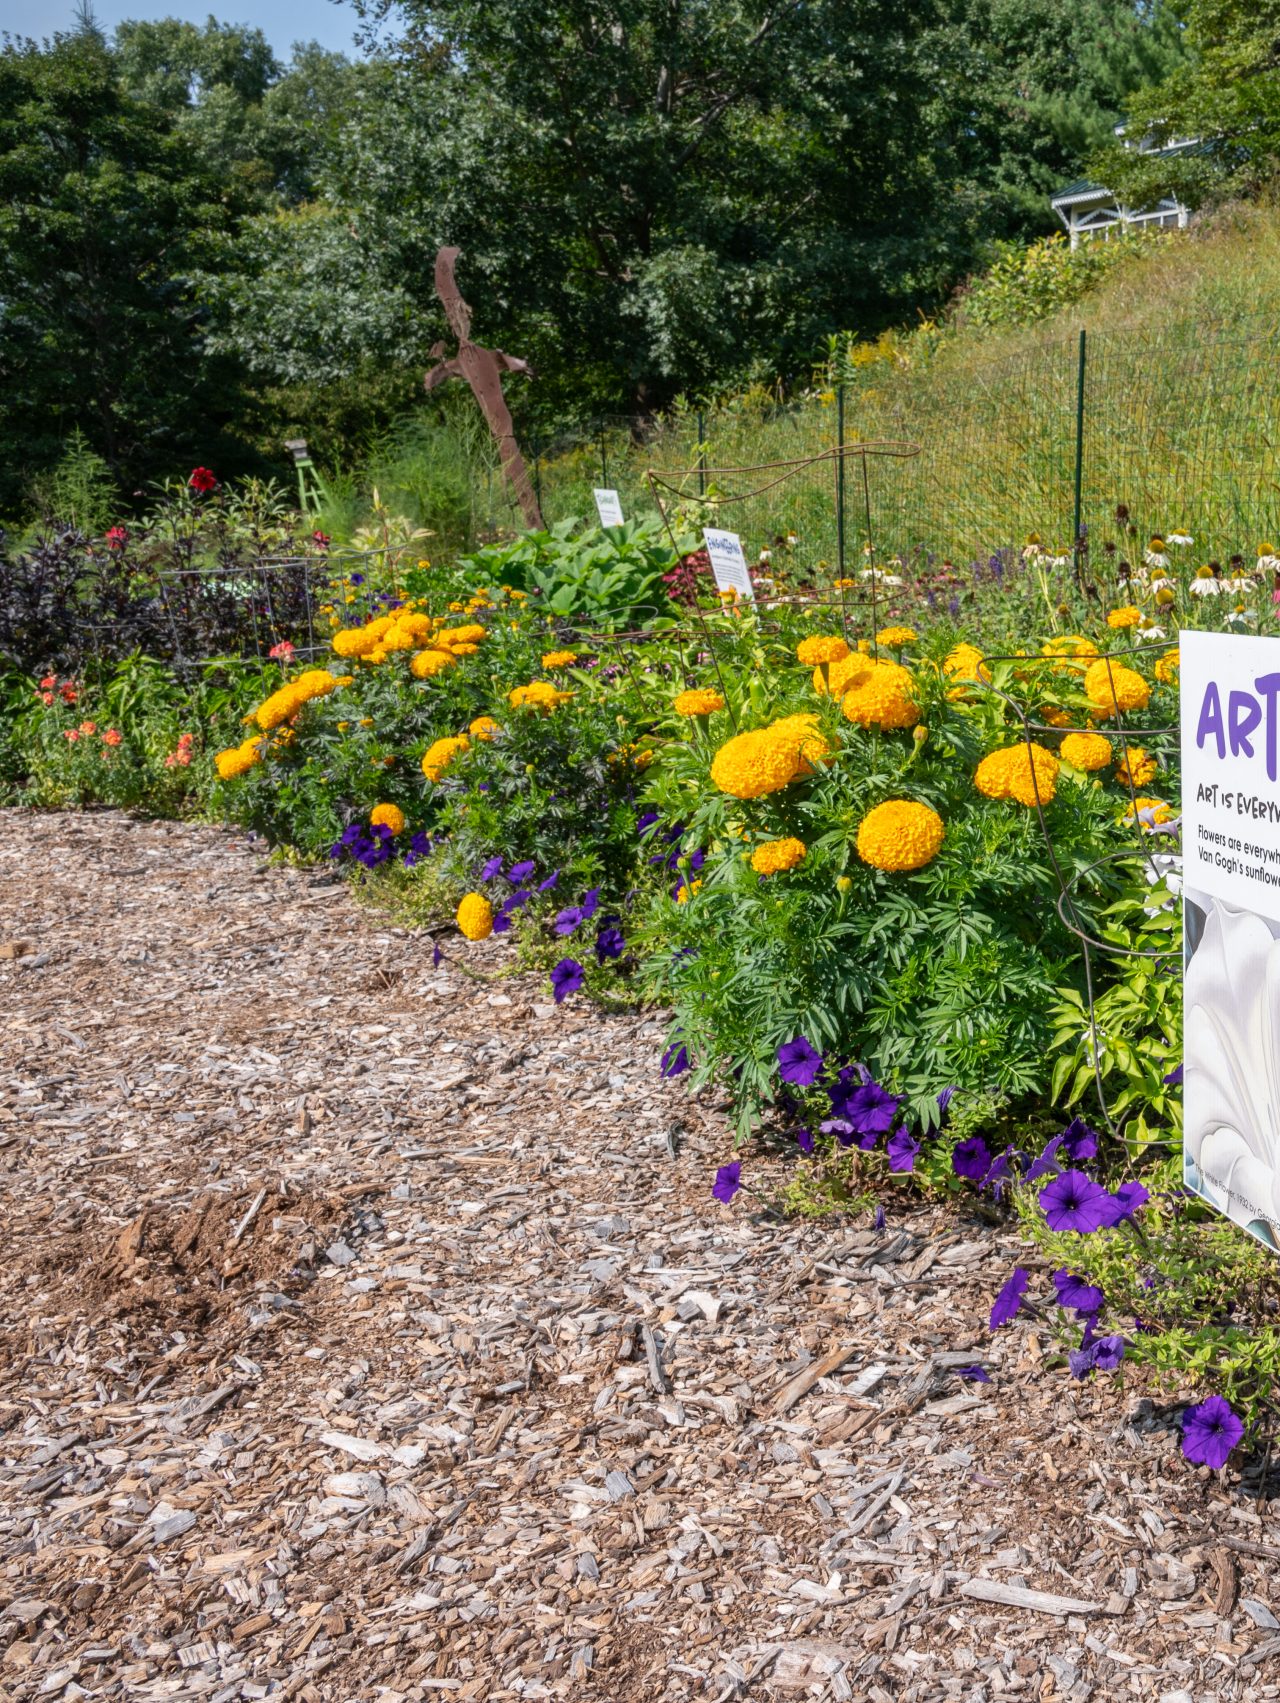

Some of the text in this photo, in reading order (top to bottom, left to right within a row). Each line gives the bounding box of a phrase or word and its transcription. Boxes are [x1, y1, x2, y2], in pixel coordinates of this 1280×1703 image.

[1197, 783, 1219, 808] ART
[1221, 792, 1234, 809] IS
[1198, 824, 1226, 847] Flowers
[1228, 838, 1242, 852] are
[1198, 845, 1213, 864] Van
[1215, 851, 1244, 875] Gogh's
[1237, 1193, 1249, 1209] 1932
[1249, 1203, 1257, 1216] by
[1258, 1208, 1280, 1231] Georgia
